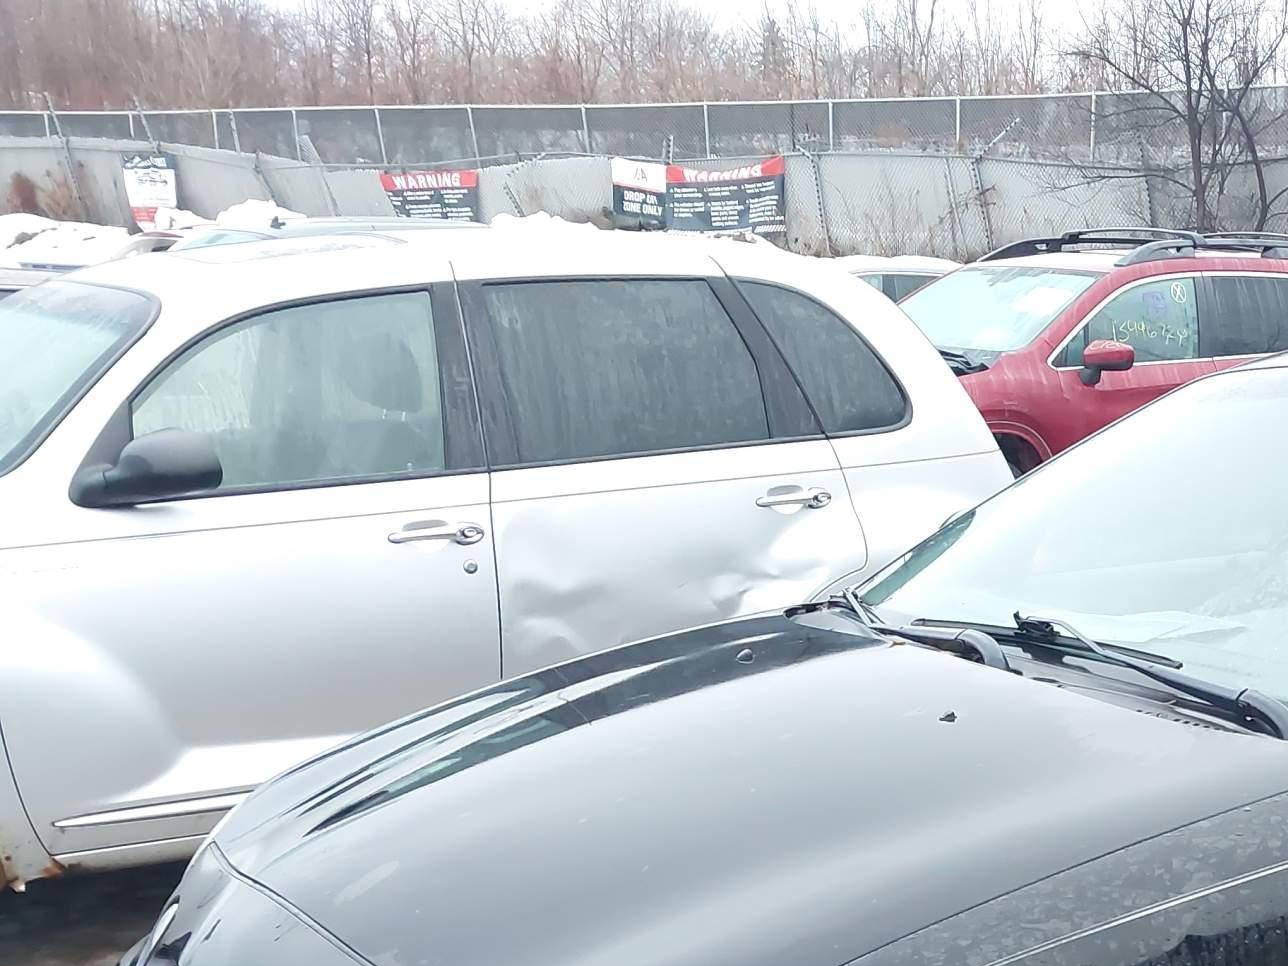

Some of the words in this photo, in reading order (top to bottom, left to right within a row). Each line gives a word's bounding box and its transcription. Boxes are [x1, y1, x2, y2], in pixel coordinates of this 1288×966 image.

[391, 172, 460, 189] WARNING
[623, 190, 645, 202] DROP
[642, 203, 663, 216] ONLY
